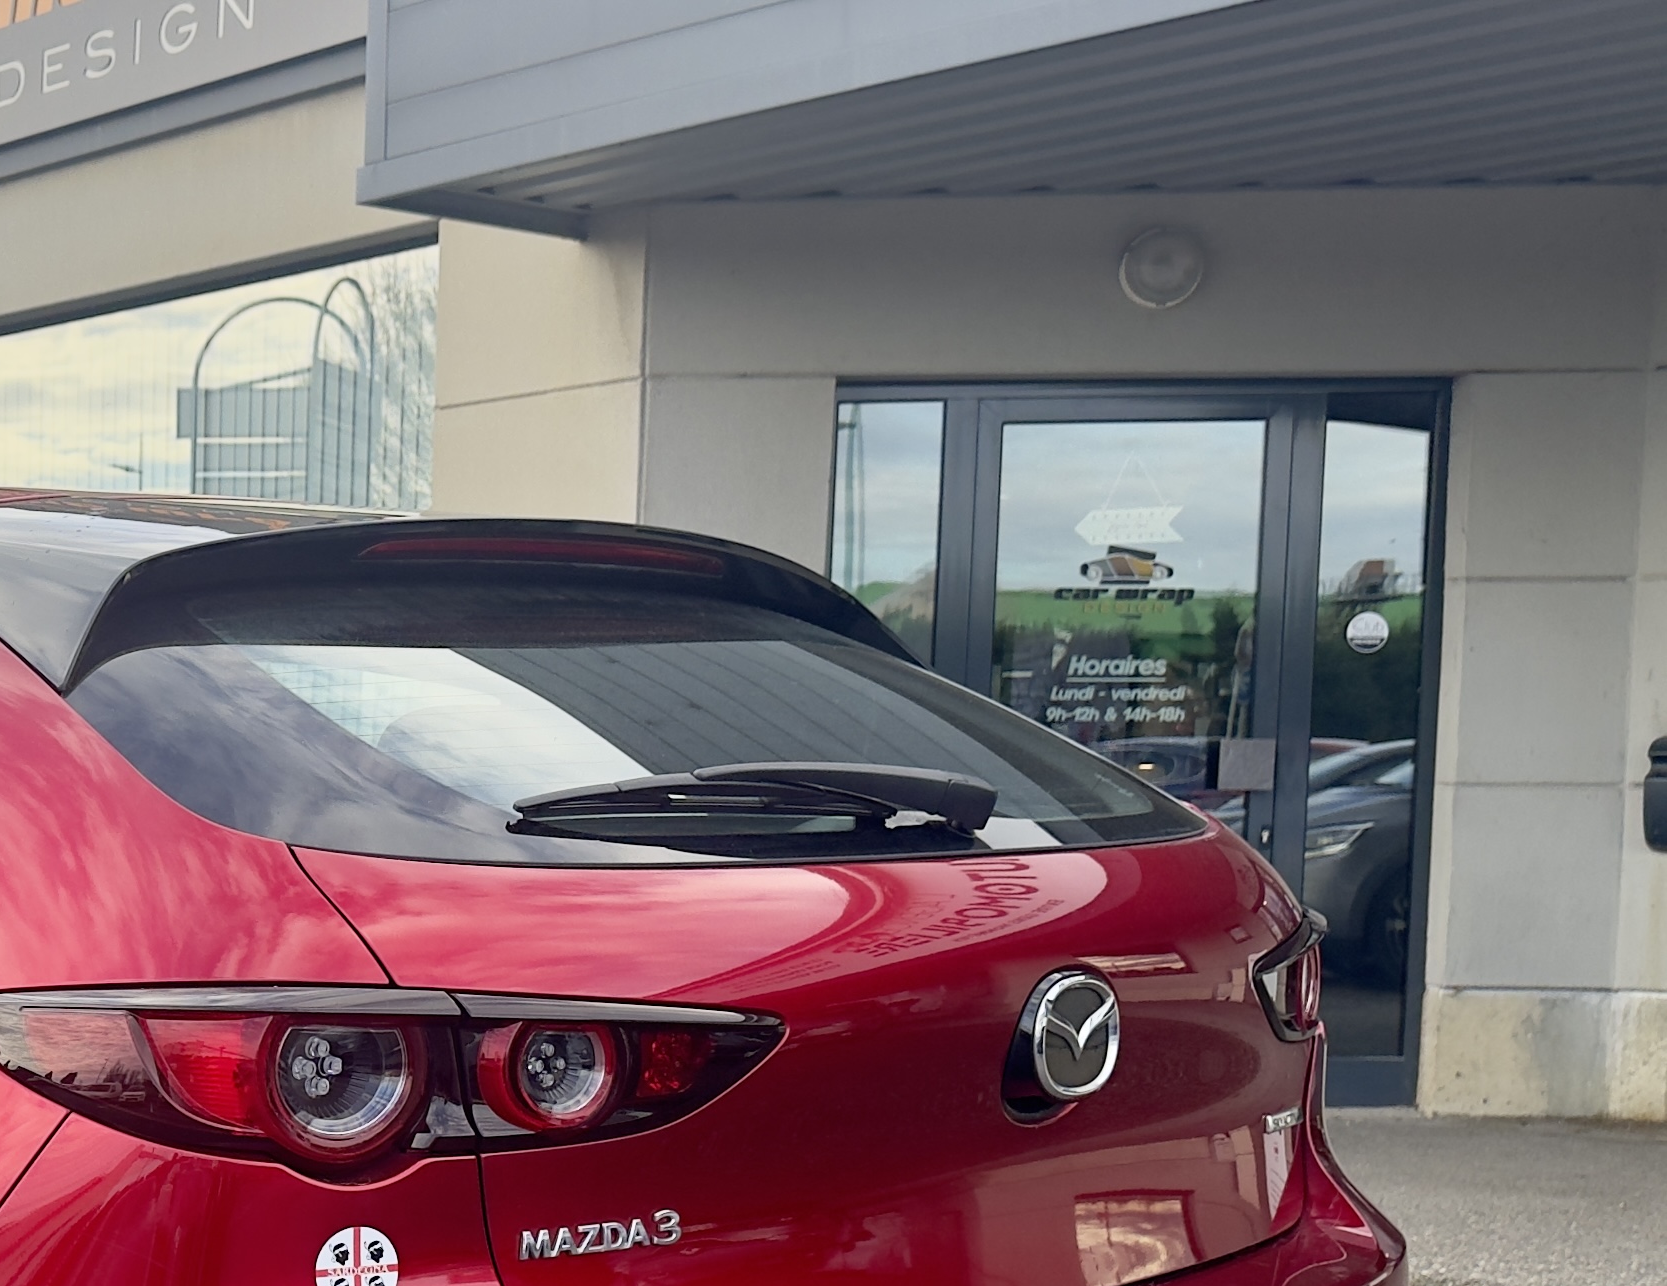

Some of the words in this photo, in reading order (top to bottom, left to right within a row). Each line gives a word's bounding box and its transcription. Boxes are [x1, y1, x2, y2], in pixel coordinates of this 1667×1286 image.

[1054, 588, 1109, 600] car
[1083, 602, 1165, 613] DESIGN
[1067, 654, 1167, 677] Horaires
[1050, 685, 1095, 701] Lundi
[1111, 685, 1186, 701] vendredi
